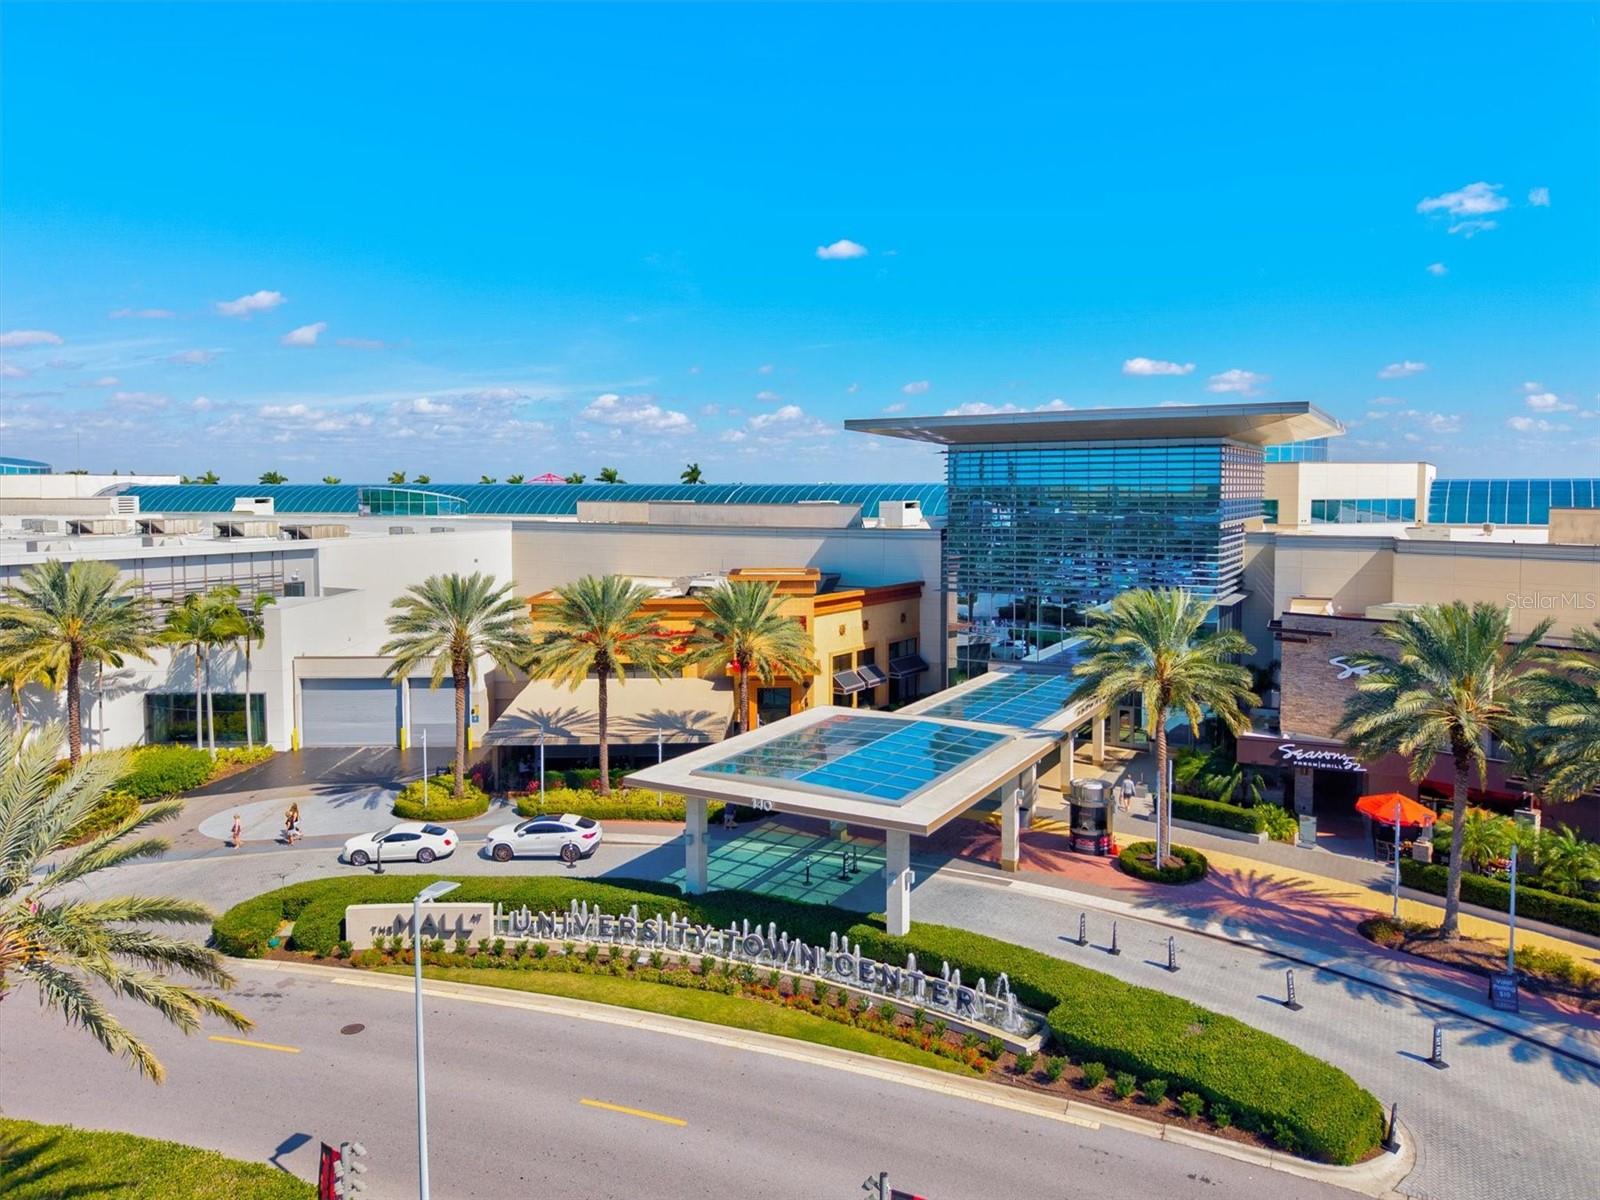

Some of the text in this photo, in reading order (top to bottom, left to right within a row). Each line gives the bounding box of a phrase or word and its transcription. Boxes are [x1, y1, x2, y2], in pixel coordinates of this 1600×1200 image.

[1278, 743, 1367, 772] Seasons 52
[369, 925, 394, 937] THE
[393, 913, 474, 940] MALL
[513, 910, 715, 948] UNIVERSITY
[724, 929, 821, 973] TOWN
[834, 952, 978, 1015] CENTER
